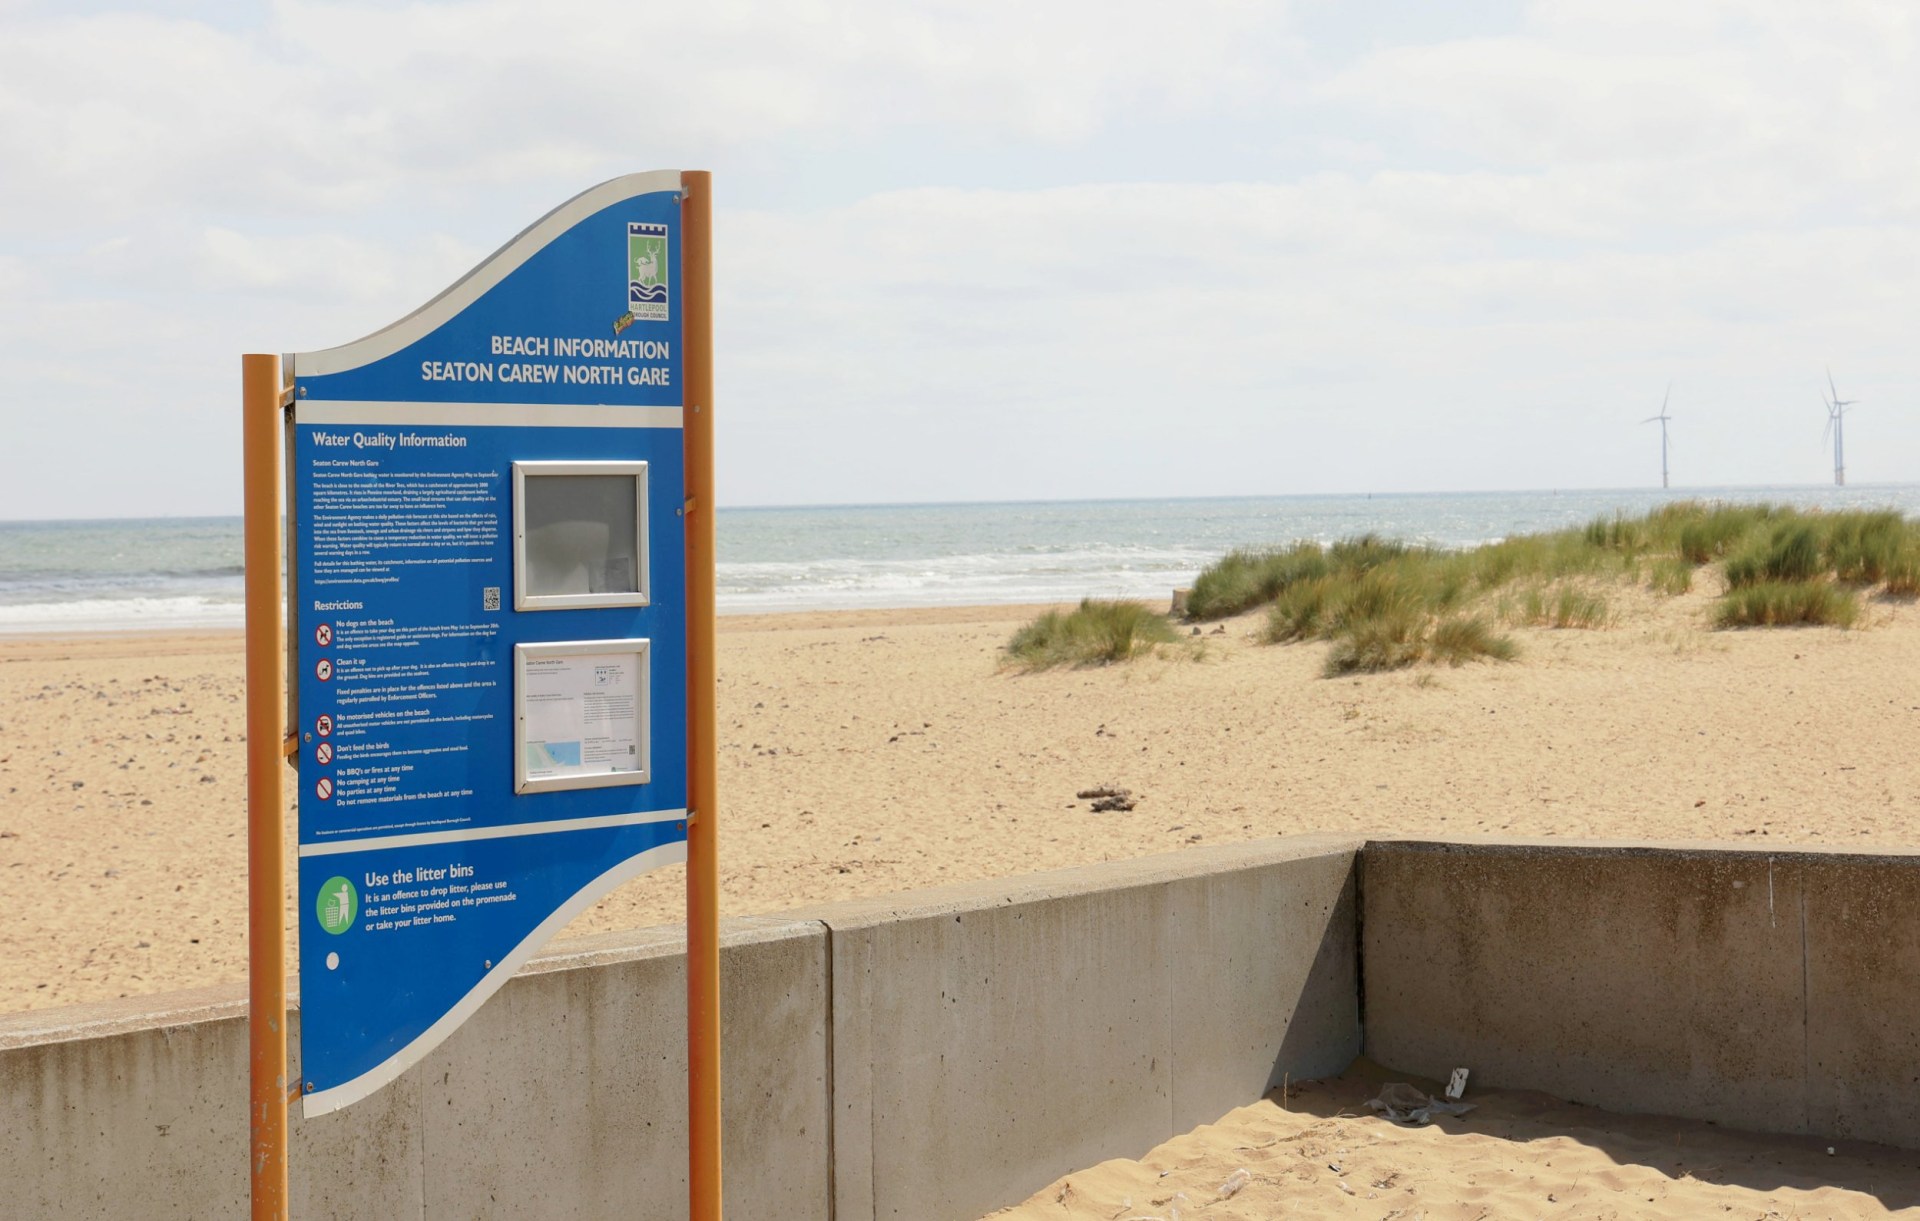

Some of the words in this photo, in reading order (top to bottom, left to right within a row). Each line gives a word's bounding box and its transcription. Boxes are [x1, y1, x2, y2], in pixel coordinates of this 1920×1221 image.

[630, 303, 667, 312] HARTLEPOOL
[491, 337, 549, 356] BEACH
[554, 338, 669, 359] INFORMATION
[422, 362, 493, 382] SEATON
[498, 363, 559, 383] CAREW
[563, 365, 623, 385] NORTH
[627, 367, 670, 386] GARE
[312, 432, 350, 446] Water
[353, 432, 396, 450] Quality
[399, 433, 467, 447] Information
[314, 600, 363, 610] Restrictions
[365, 872, 389, 887] Use
[392, 870, 413, 885] the
[416, 867, 446, 882] litter
[450, 863, 474, 878] bins
[365, 894, 372, 903] It
[373, 894, 379, 902] is
[392, 890, 419, 900] offence
[430, 887, 448, 897] drop
[449, 885, 469, 894] litter,
[470, 883, 493, 894] please
[365, 908, 378, 917] the
[380, 906, 398, 915] litter
[400, 904, 416, 913] bins
[417, 899, 450, 913] provided
[462, 897, 474, 906] the
[476, 892, 517, 907] promenade
[376, 920, 393, 930] take
[395, 920, 411, 930] your
[413, 917, 431, 926] litter
[433, 915, 456, 923] home.
